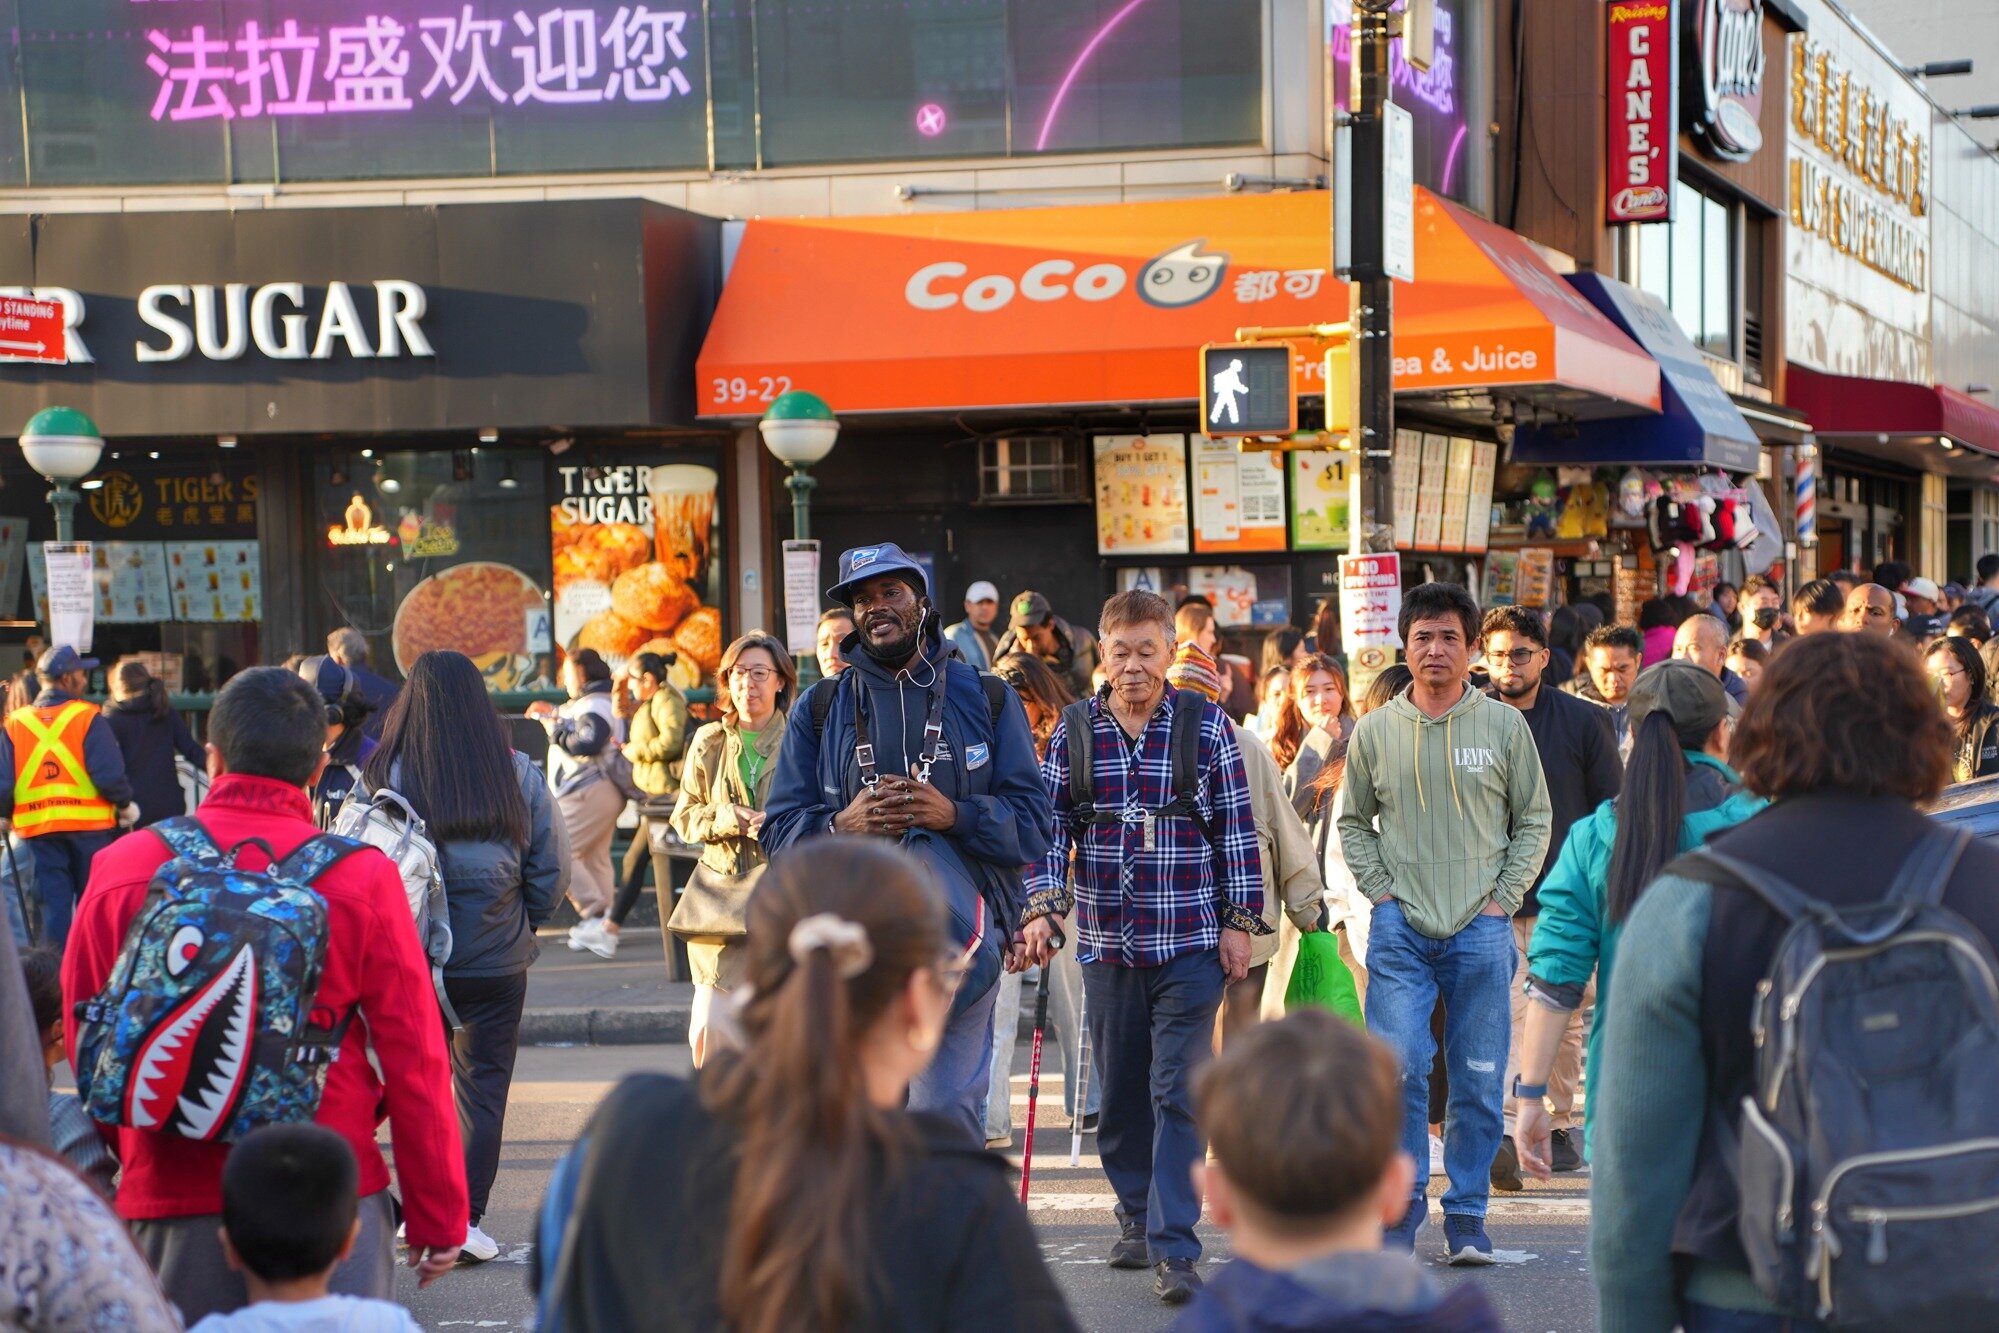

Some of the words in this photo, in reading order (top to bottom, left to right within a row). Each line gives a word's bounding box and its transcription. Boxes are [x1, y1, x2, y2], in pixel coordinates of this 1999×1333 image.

[1611, 4, 1668, 22] Raising
[146, 5, 691, 121] 法拉盛欢迎您
[1626, 25, 1660, 185] CANE'S
[905, 258, 1127, 312] CoCo
[1233, 267, 1326, 302] 都可
[4, 301, 55, 320] STANDING
[136, 279, 436, 363] SUGAR
[1430, 346, 1453, 374] &
[1462, 344, 1538, 372] Juice
[712, 375, 793, 404] 39-22
[154, 477, 233, 504] TIGER
[558, 465, 653, 495] TIGER
[560, 496, 655, 525] SUGAR
[1135, 570, 1153, 590] A
[1344, 573, 1396, 588] STOPPING
[1359, 560, 1379, 574] NO
[533, 615, 551, 638] A
[1454, 747, 1494, 767] LEVI'S
